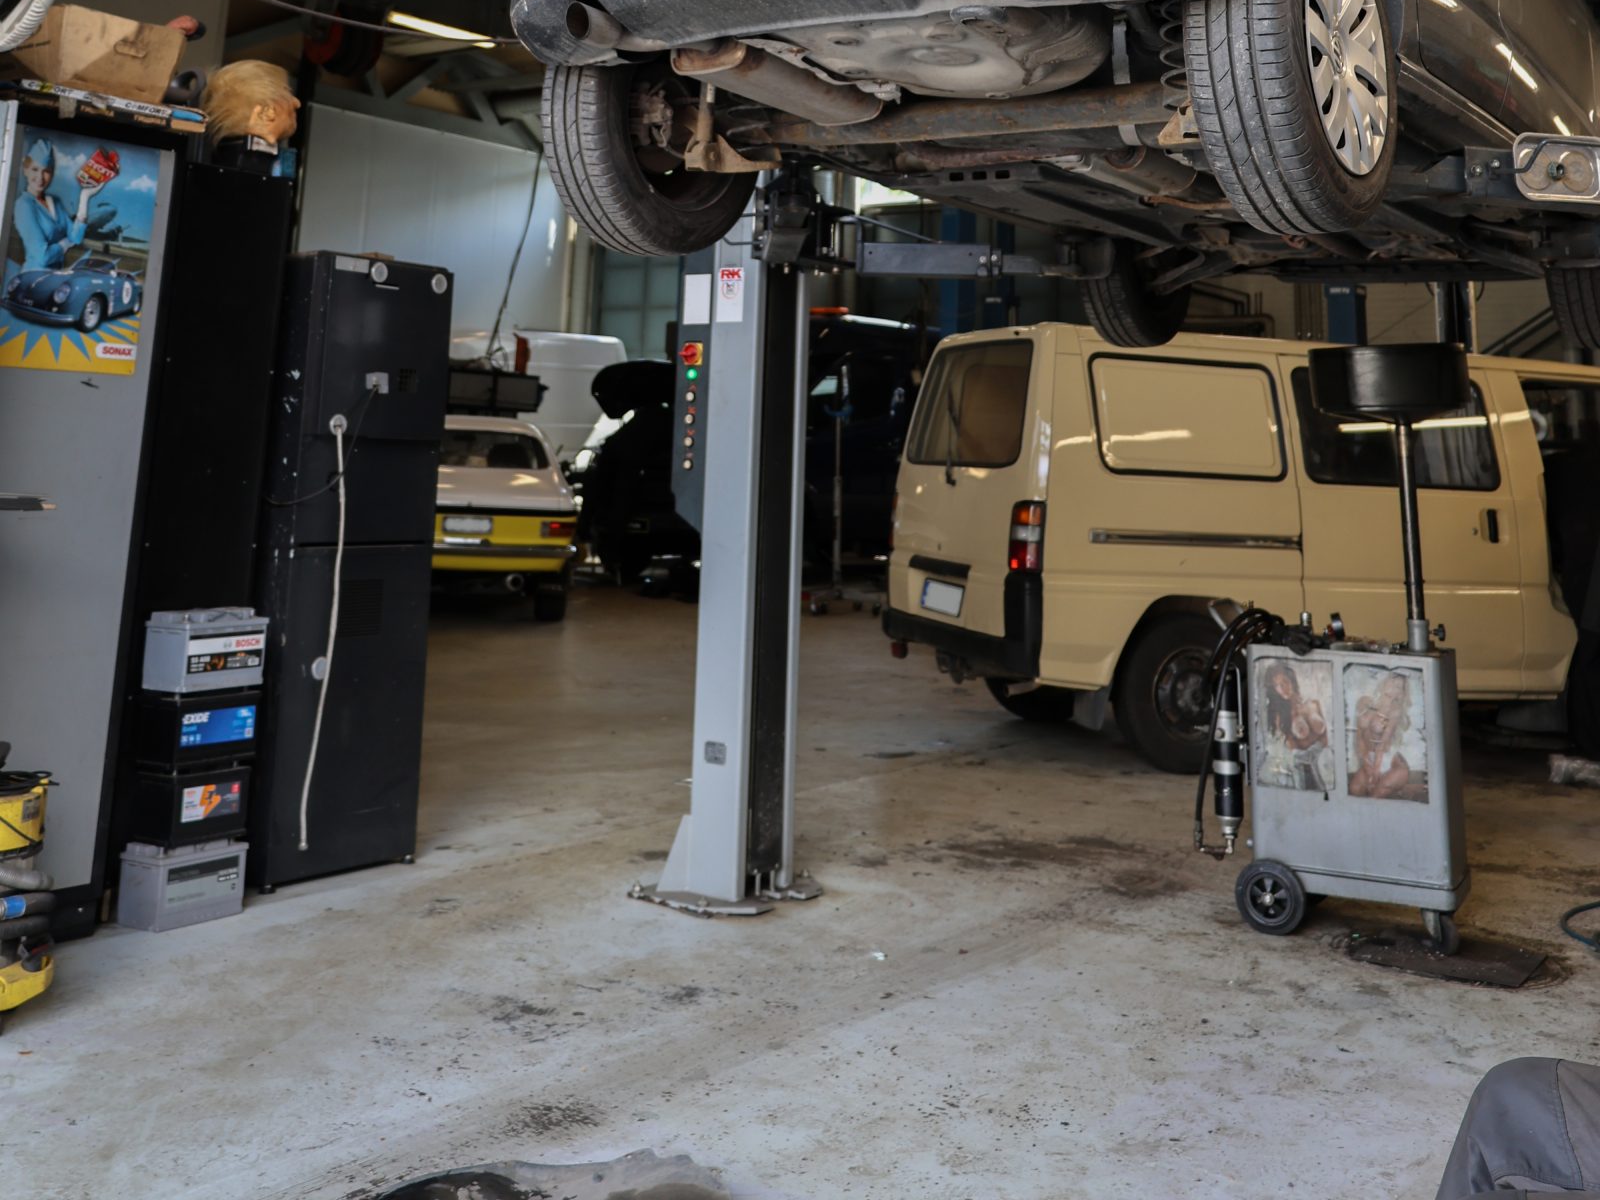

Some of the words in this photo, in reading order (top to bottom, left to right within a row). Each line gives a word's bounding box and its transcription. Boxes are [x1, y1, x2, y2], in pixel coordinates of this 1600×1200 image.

[102, 345, 133, 357] SONAX
[235, 638, 261, 648] BOSCH
[182, 711, 211, 725] EXIDE
